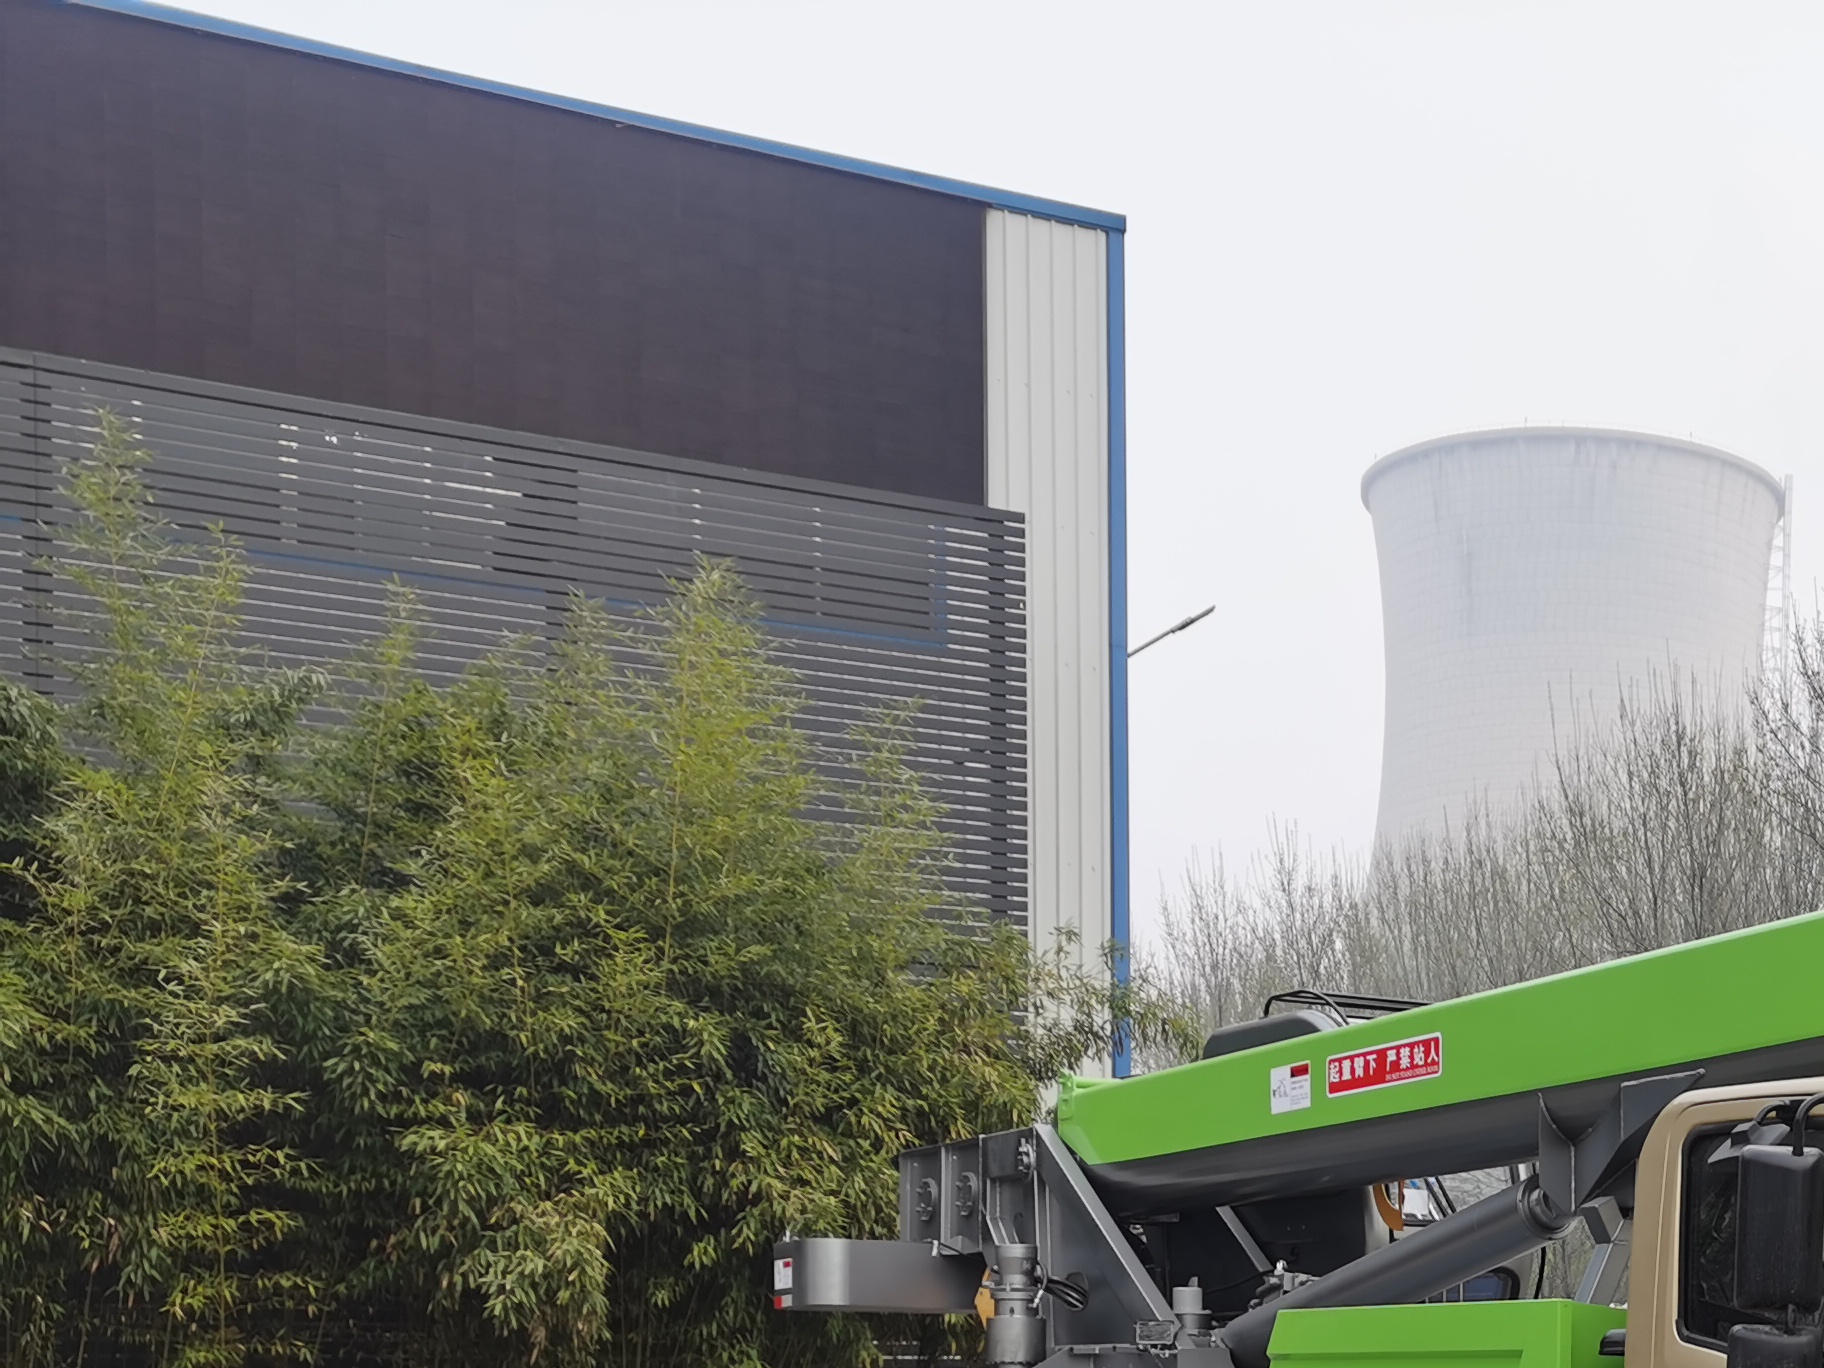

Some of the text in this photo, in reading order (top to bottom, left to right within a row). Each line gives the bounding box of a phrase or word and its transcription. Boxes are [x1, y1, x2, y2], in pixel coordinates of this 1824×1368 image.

[1329, 1053, 1377, 1083] 起重臂下
[1386, 1040, 1438, 1072] 严禁站人
